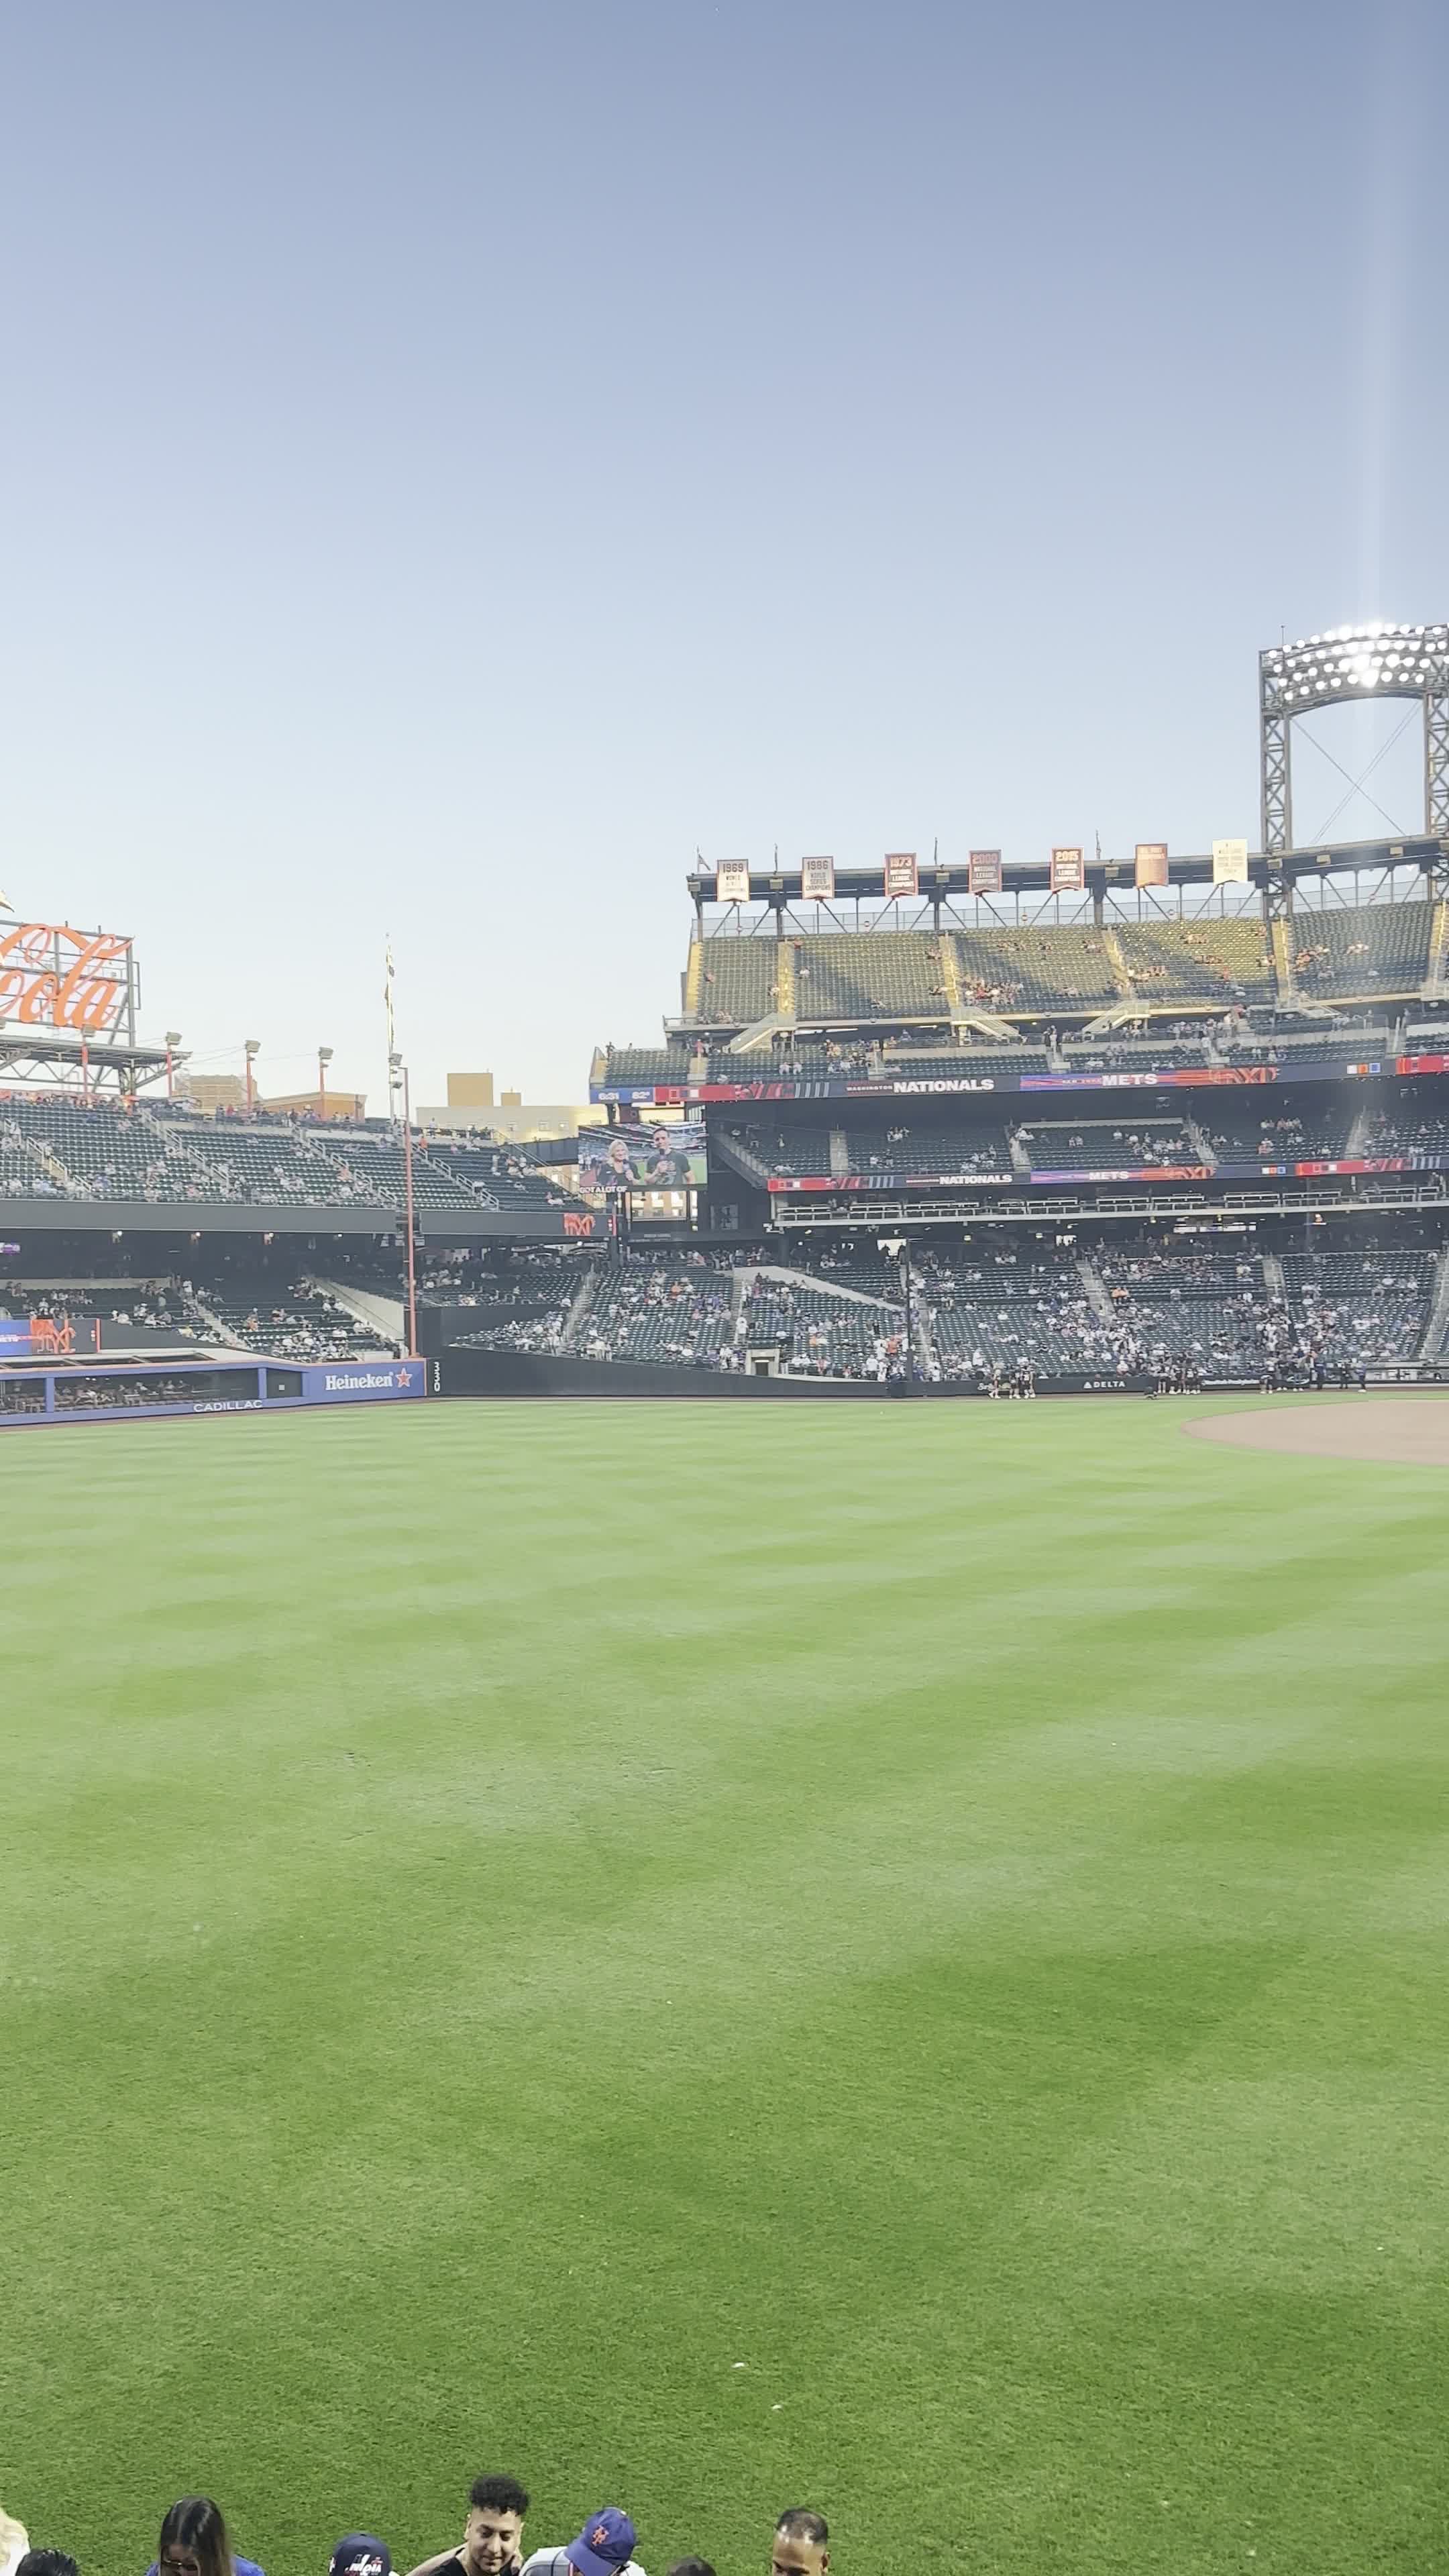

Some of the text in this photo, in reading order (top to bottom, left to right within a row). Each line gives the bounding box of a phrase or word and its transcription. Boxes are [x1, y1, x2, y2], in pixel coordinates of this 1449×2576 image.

[723, 863, 744, 873] 1969
[807, 860, 828, 870] 1986
[1102, 1073, 1158, 1086] METS
[894, 1079, 994, 1093] NATIONALS
[939, 1175, 1012, 1185] NATIONALS
[1089, 1171, 1129, 1180] METS
[325, 1374, 393, 1391] Heineken
[1093, 1381, 1126, 1389] DELTA
[193, 1400, 262, 1412] CADILLAC
